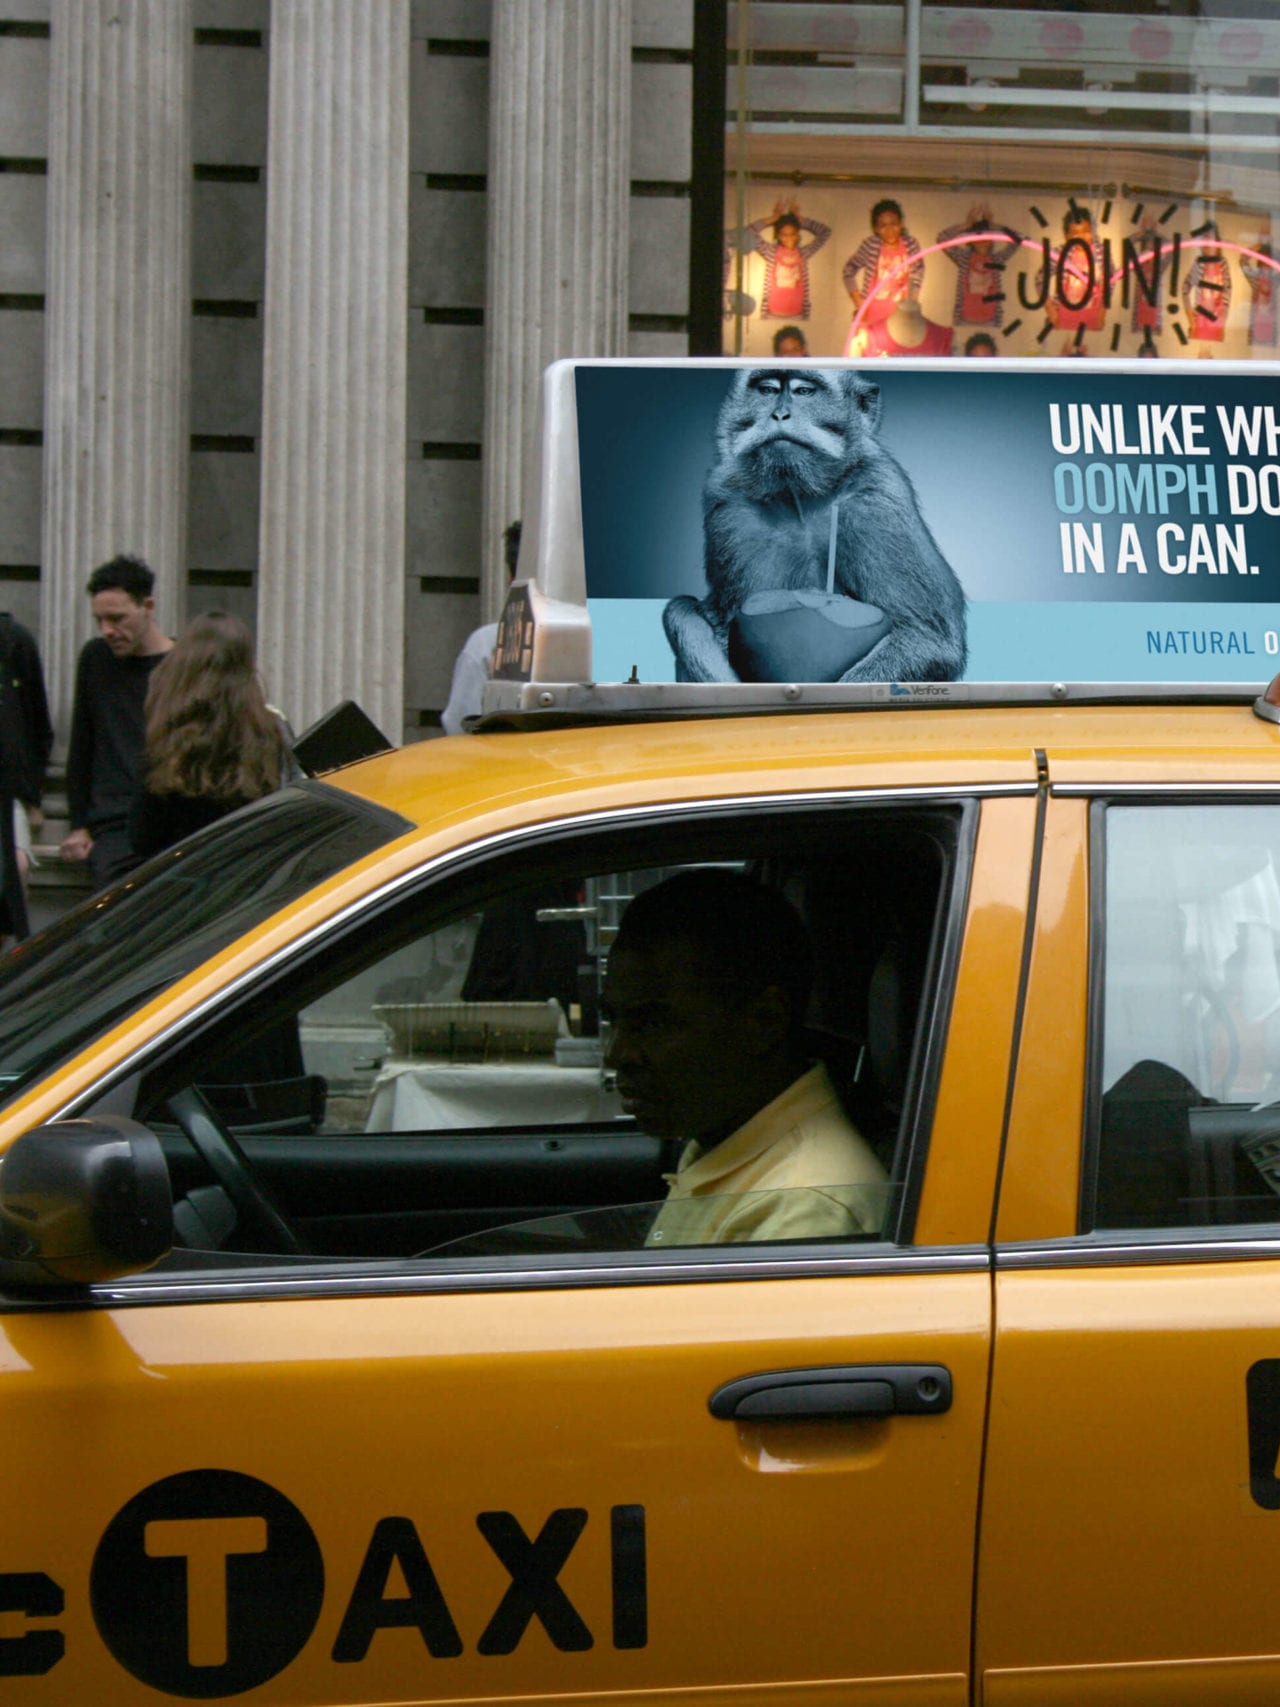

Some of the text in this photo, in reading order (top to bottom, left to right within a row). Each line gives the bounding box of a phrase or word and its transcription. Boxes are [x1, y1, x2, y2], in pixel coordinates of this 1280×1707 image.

[1017, 232, 1181, 314] JOIN!
[1049, 403, 1210, 454] UNLIKE
[1053, 462, 1219, 515] OOMPH
[1059, 522, 1260, 575] IN A CAN.
[1146, 630, 1255, 655] NATURAL
[143, 1503, 649, 1668] TAXI
